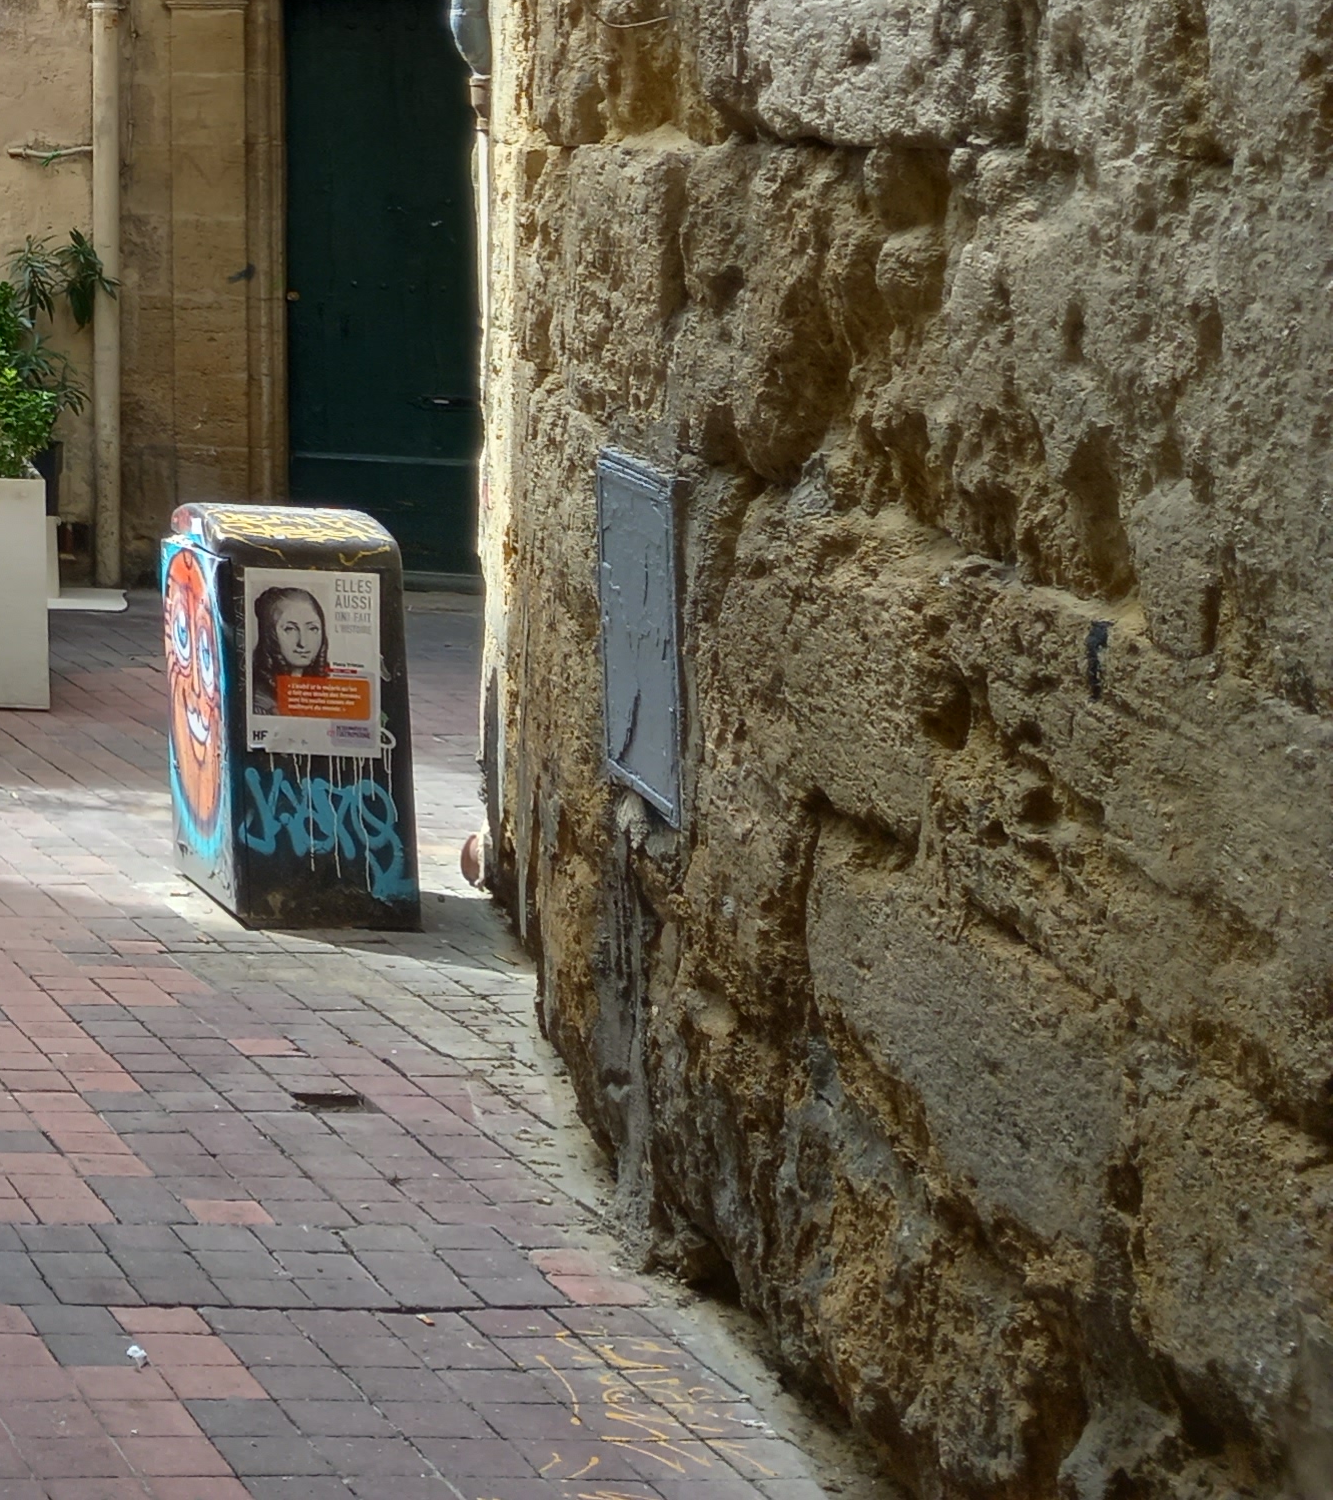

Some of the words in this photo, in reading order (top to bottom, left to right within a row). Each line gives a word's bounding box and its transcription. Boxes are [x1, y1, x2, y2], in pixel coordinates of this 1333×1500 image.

[335, 578, 372, 593] ELLES
[335, 595, 372, 610] AUSSI
[335, 611, 351, 622] ONT
[353, 612, 372, 623] FAIT
[252, 730, 269, 741] HF
